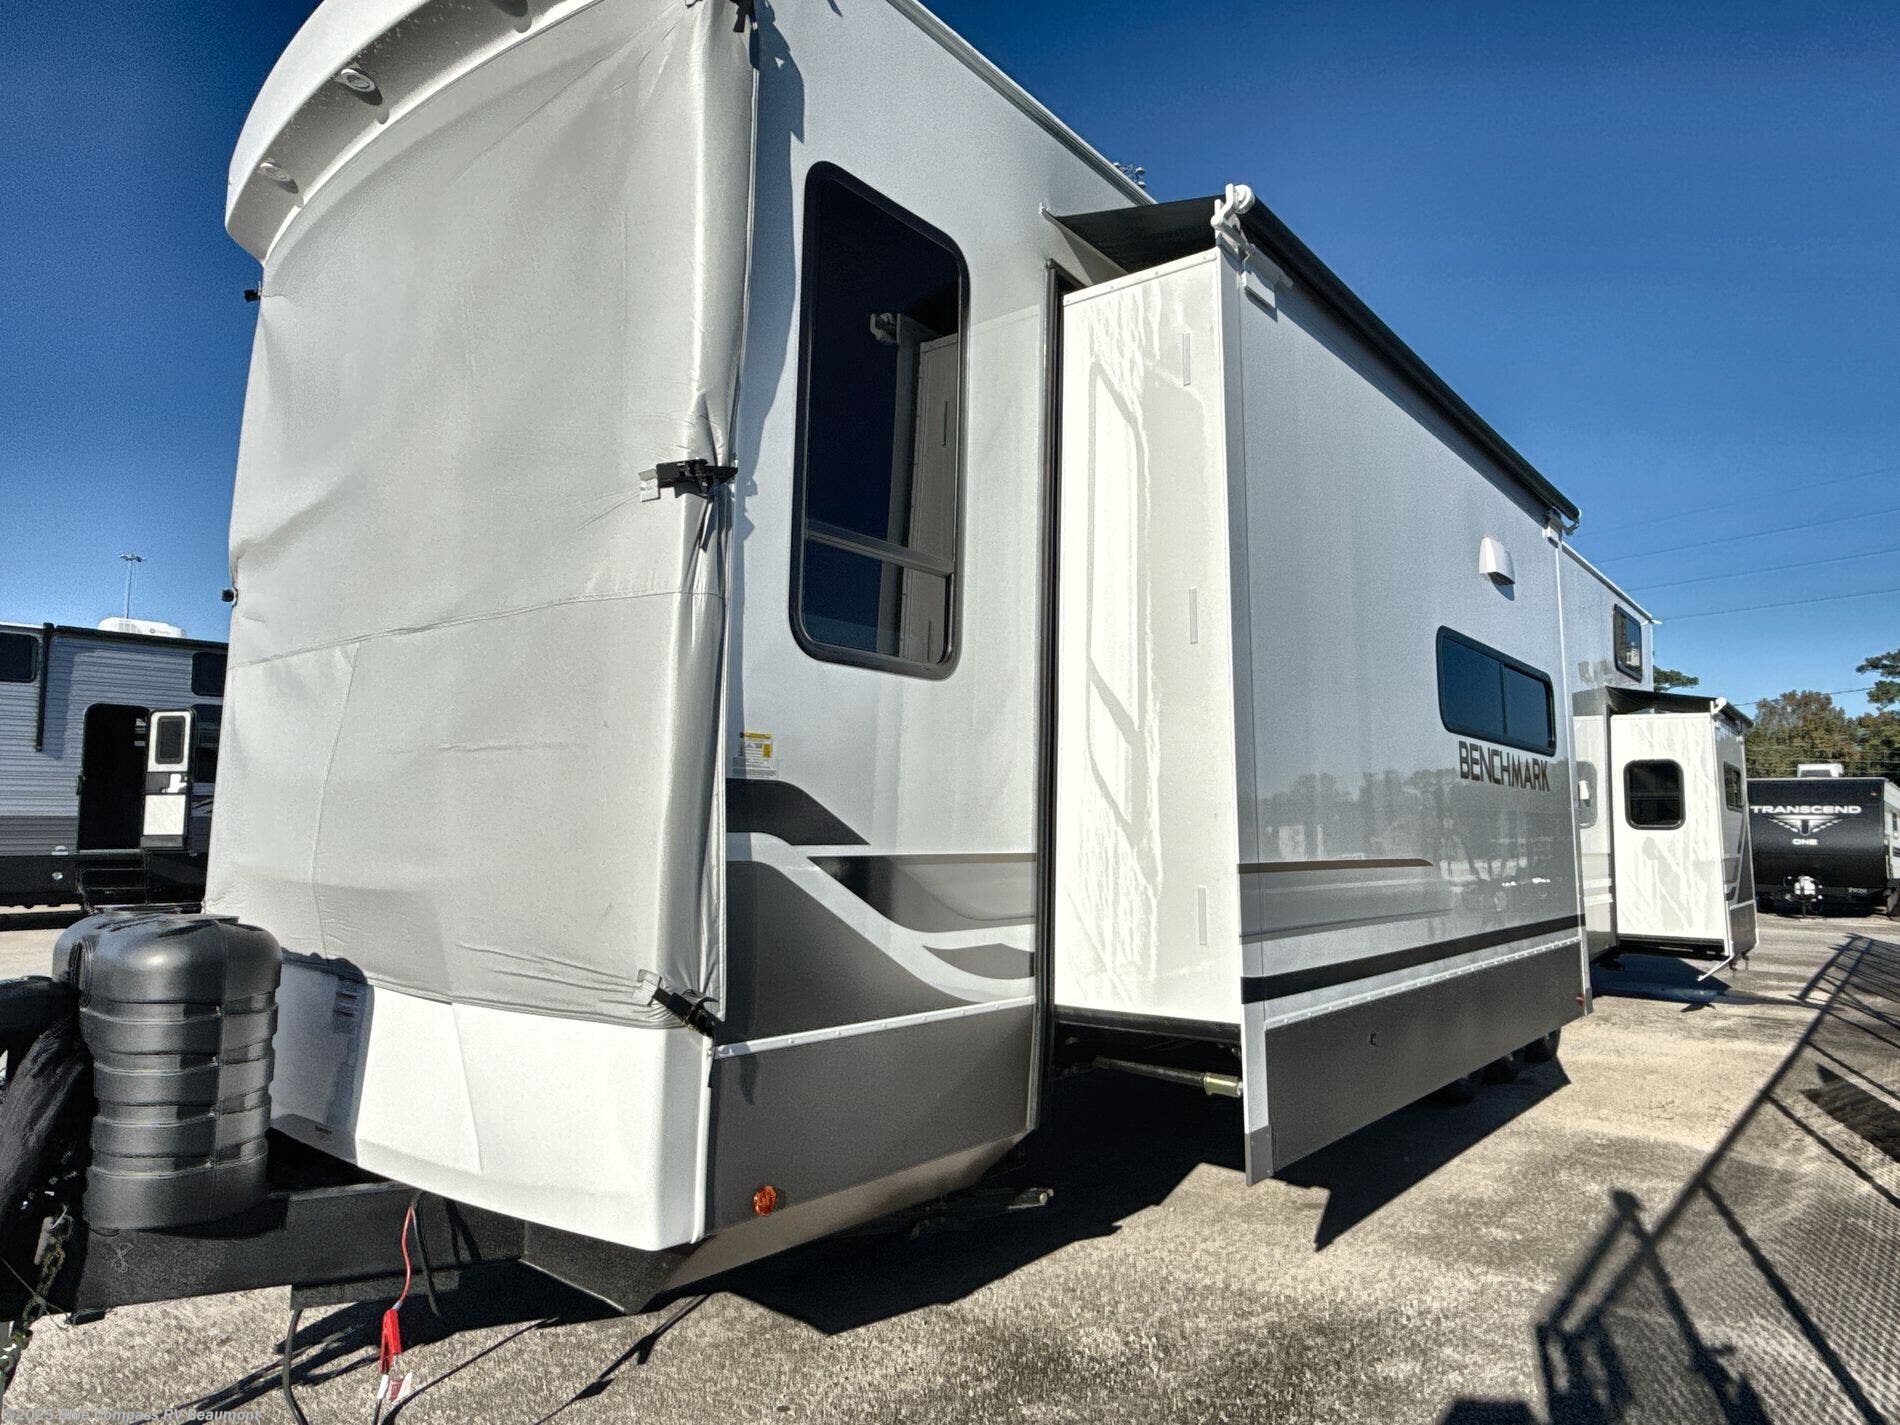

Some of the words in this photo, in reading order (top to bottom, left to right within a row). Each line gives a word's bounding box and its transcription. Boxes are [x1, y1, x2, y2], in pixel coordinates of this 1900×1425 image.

[1459, 740, 1550, 792] BENCHMARK
[1750, 805, 1862, 814] TRANSCEND
[1792, 838, 1818, 846] ONE
